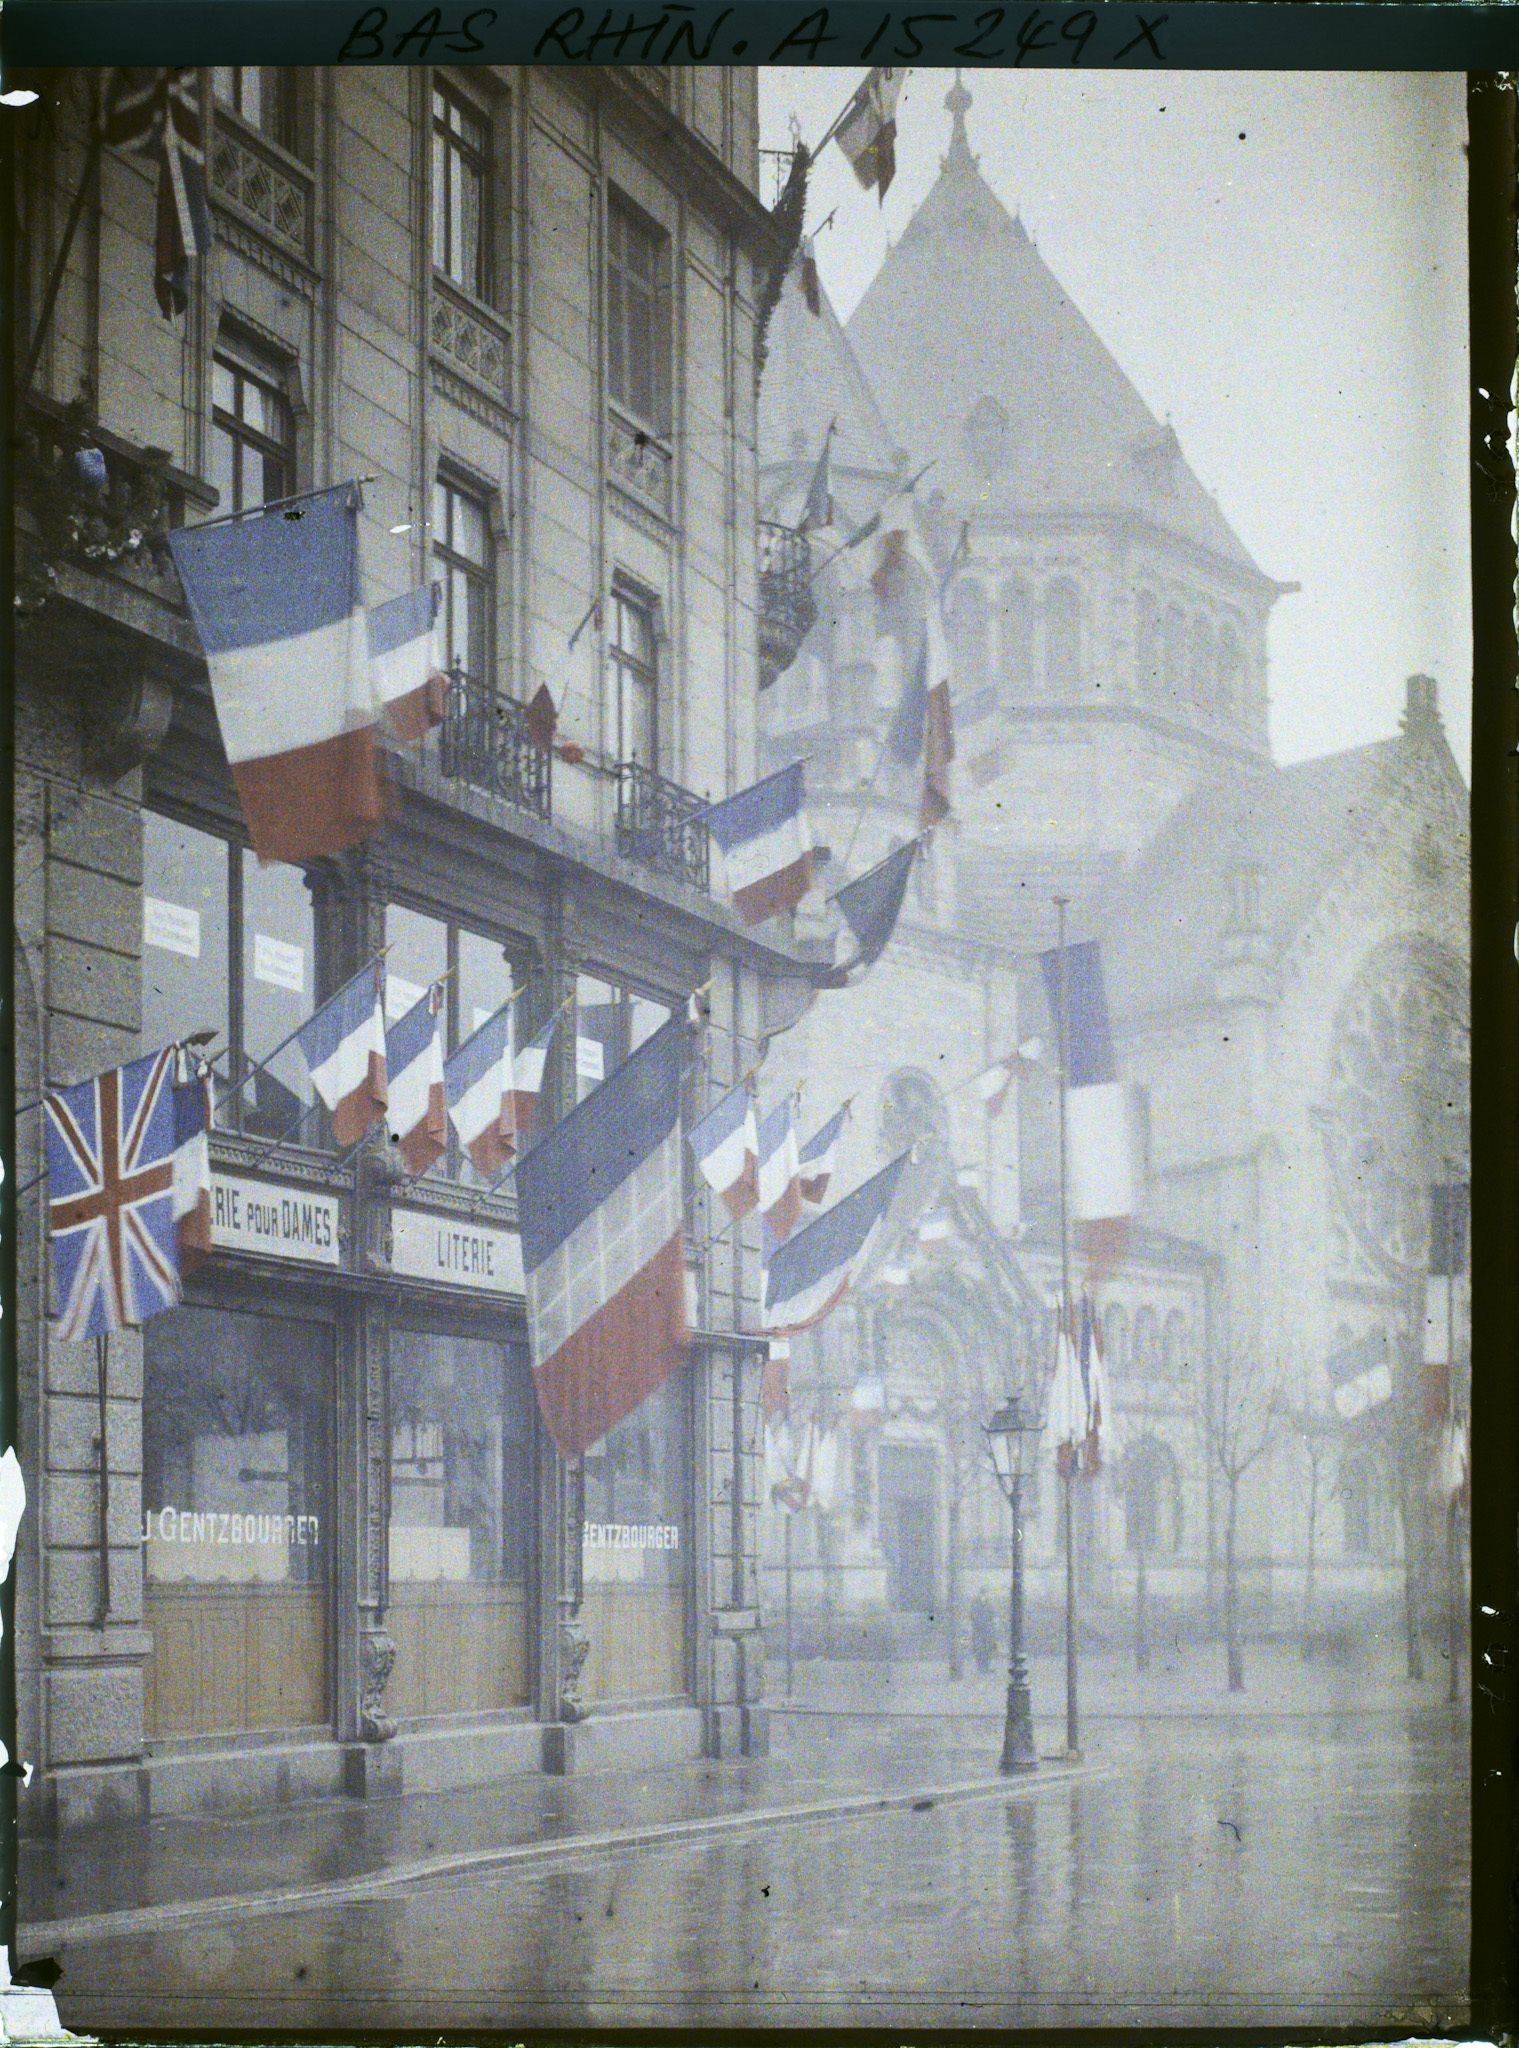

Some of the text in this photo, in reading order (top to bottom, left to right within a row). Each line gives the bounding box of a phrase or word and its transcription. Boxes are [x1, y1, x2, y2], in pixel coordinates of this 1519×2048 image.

[337, 7, 498, 63] BAS
[209, 1185, 331, 1248] RIE POUR DAMES
[437, 1230, 495, 1277] LITERIE
